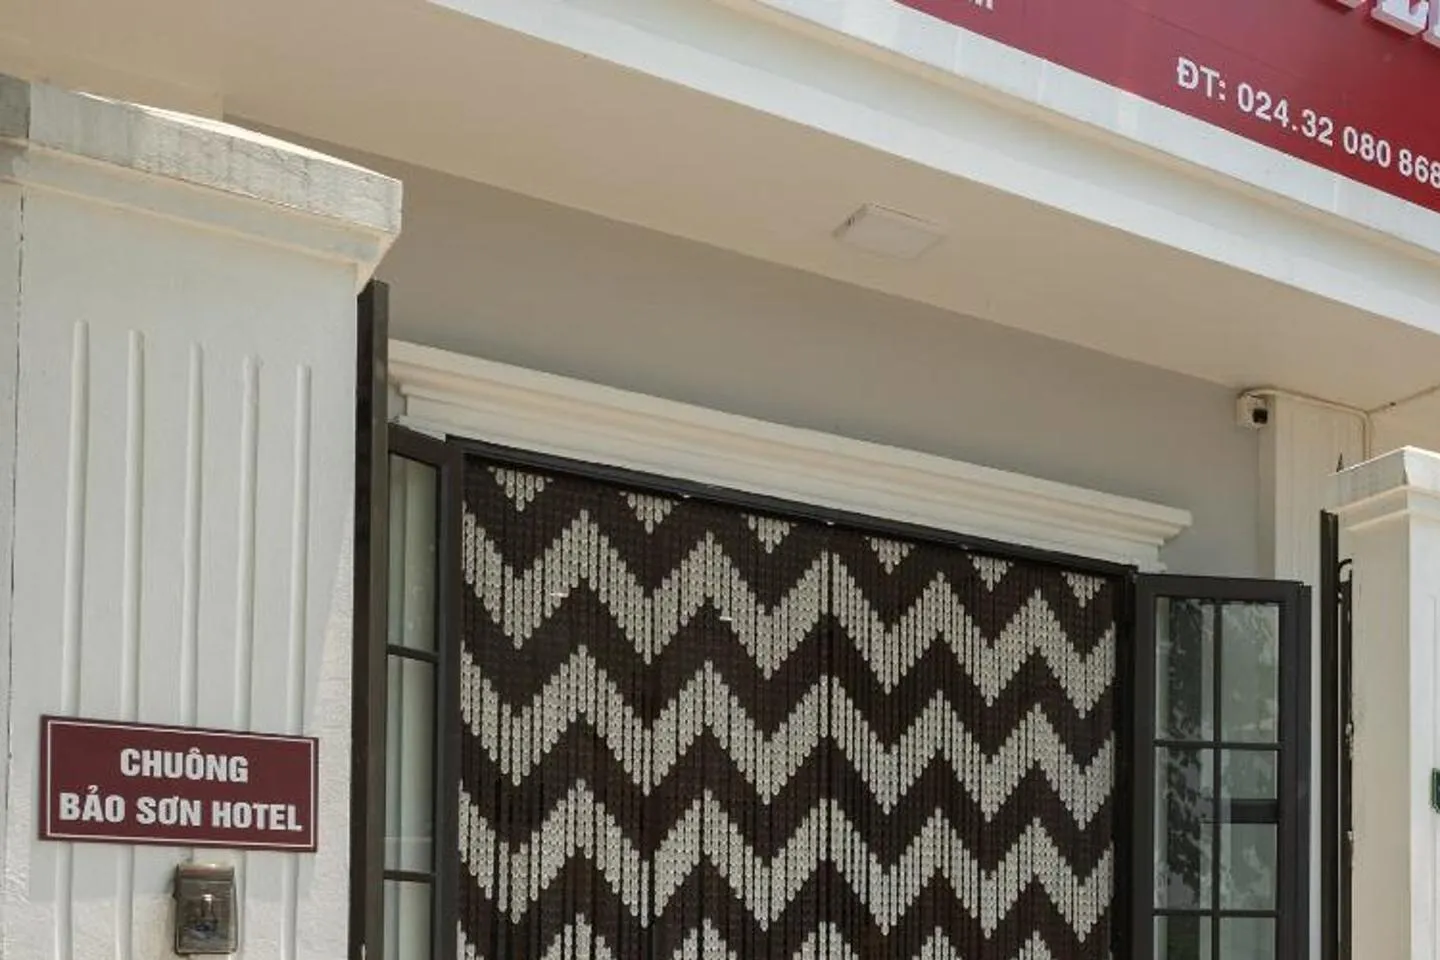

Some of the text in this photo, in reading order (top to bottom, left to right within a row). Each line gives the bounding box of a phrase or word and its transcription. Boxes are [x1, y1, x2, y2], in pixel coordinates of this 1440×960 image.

[1177, 57, 1226, 101] ĐT:
[1238, 83, 1334, 147] 024.32
[1343, 126, 1392, 168] 080
[120, 747, 249, 783] CHUÔNG
[59, 785, 303, 832] BẢO SƠN HOTEL
